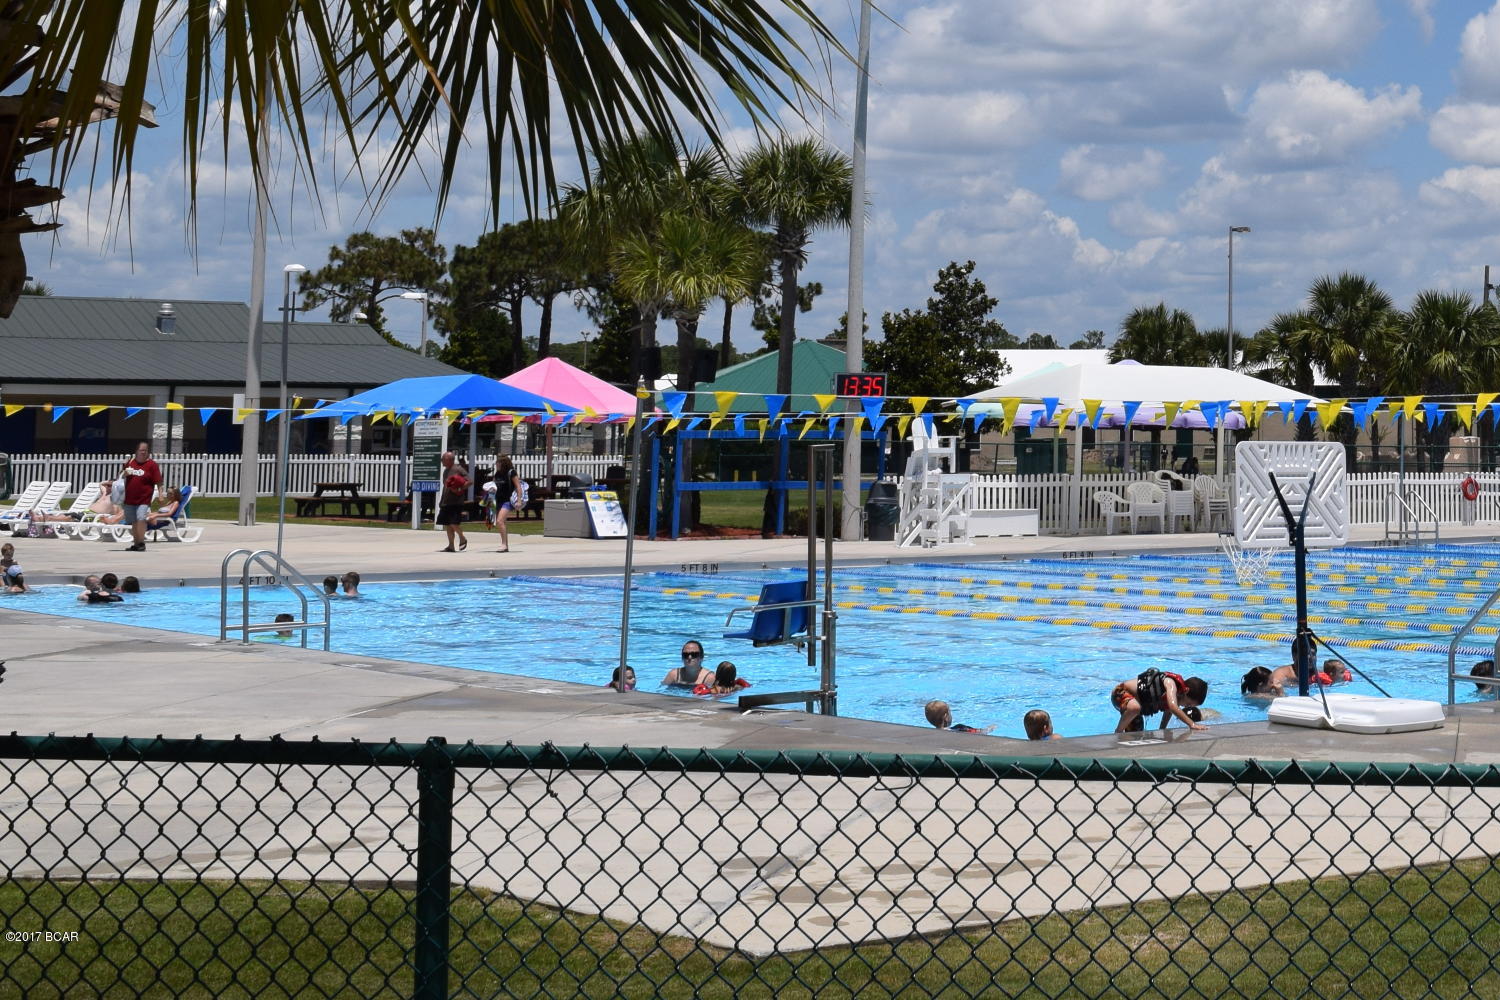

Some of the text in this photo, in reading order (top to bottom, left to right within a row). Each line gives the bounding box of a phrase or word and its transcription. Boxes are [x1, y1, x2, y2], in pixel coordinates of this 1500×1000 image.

[412, 482, 440, 491] NO DIVING
[681, 564, 687, 572] 5
[690, 563, 700, 571] FT
[711, 563, 719, 571] IN
[250, 576, 261, 585] FT
[265, 576, 276, 585] 10
